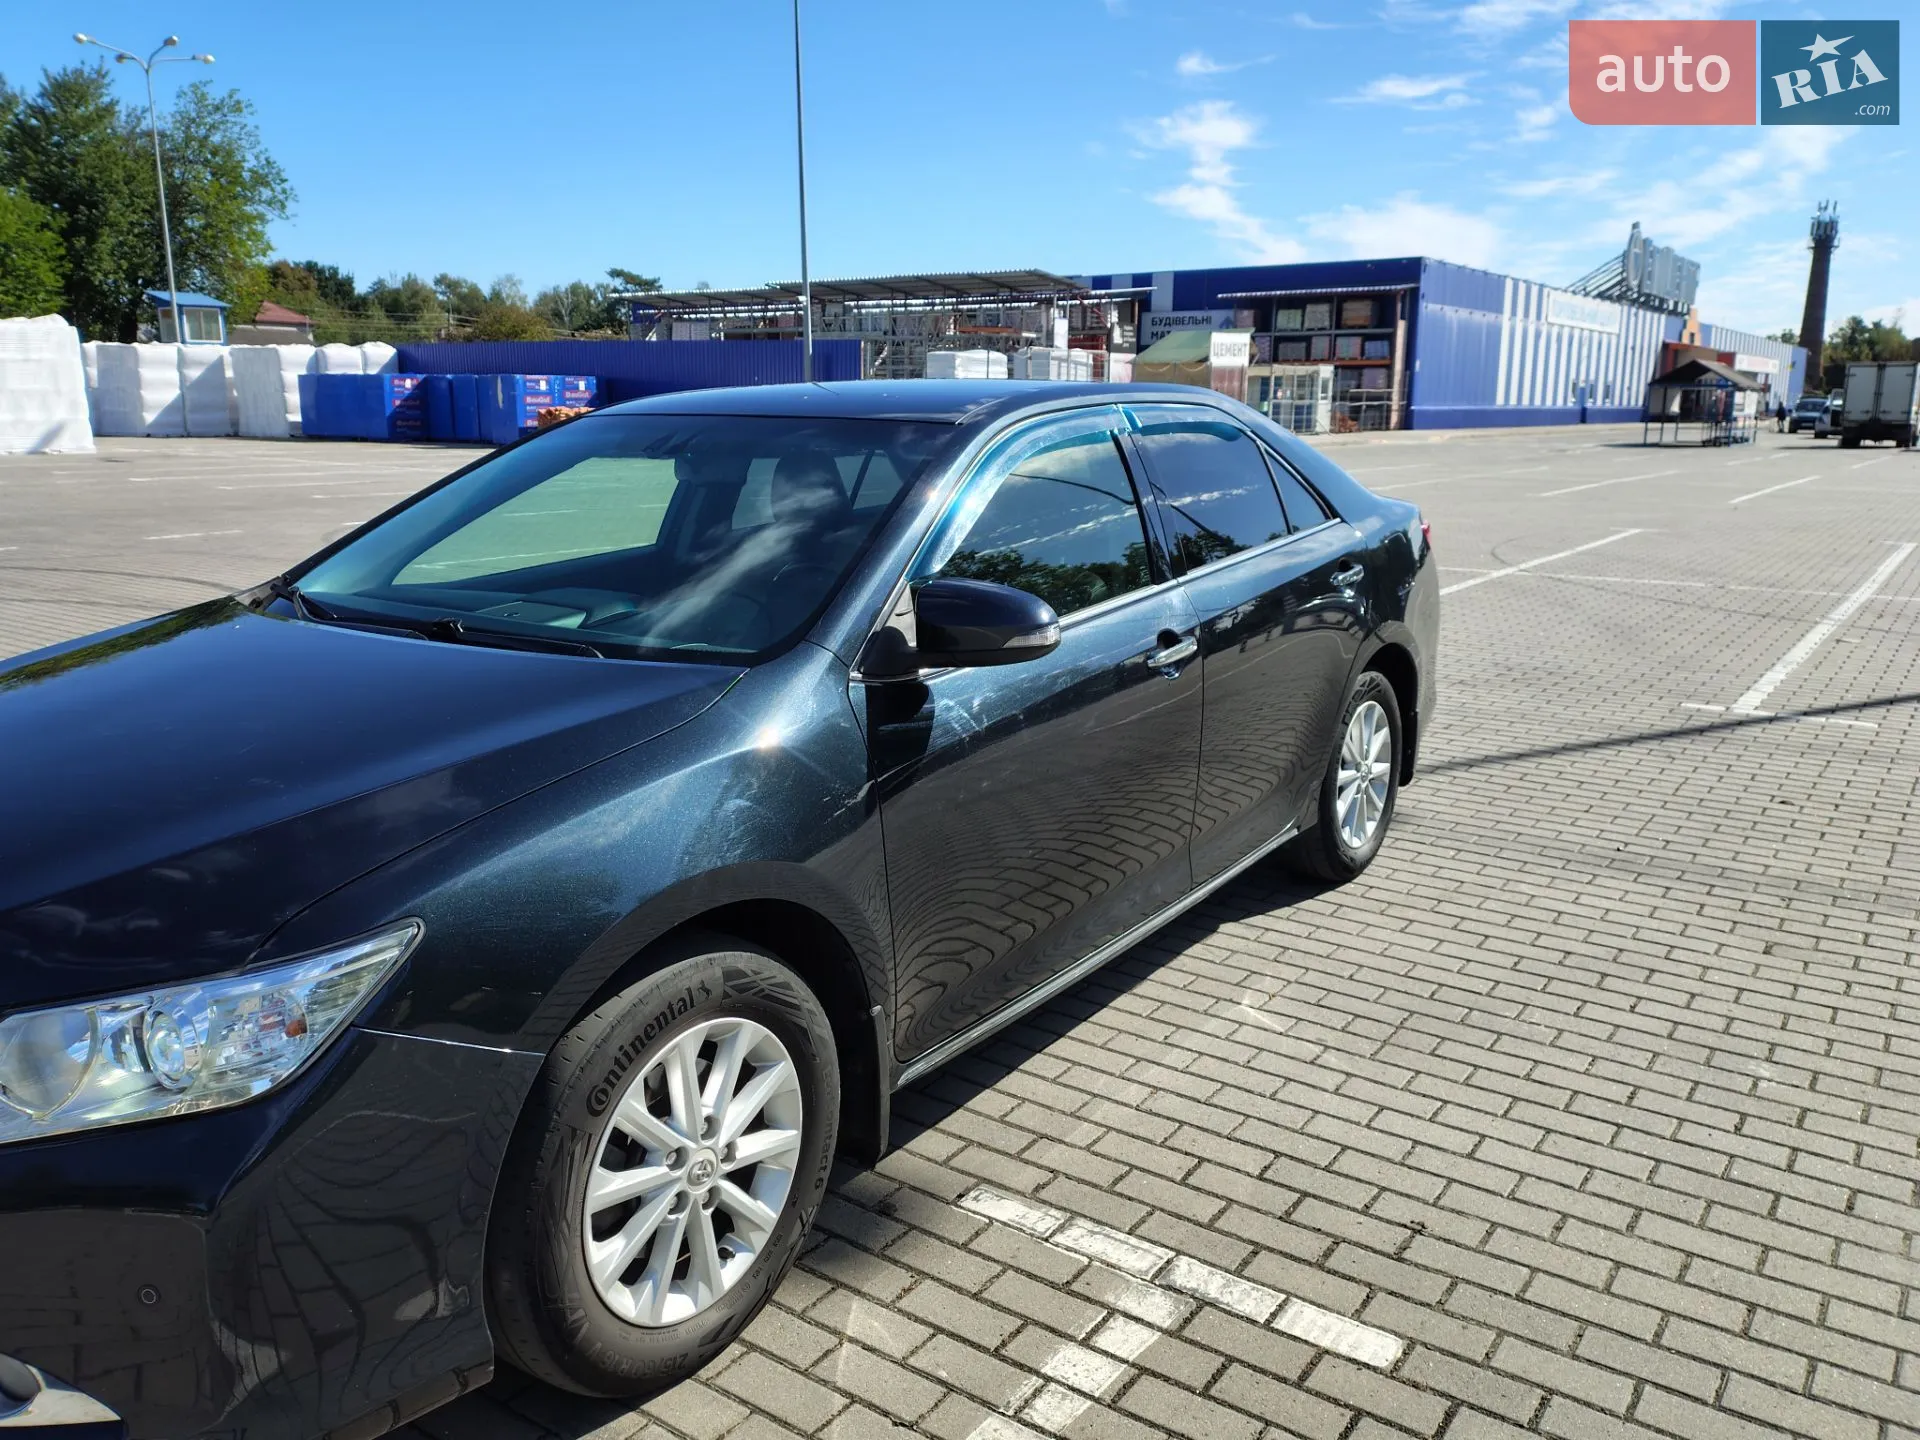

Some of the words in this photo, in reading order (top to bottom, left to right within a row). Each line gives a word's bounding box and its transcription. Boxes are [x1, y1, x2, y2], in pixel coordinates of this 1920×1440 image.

[1151, 315, 1212, 327] БУДІВЕЛЬНІ
[1212, 342, 1248, 358] ЦЕМЕНТ
[586, 987, 696, 1117] Continental
